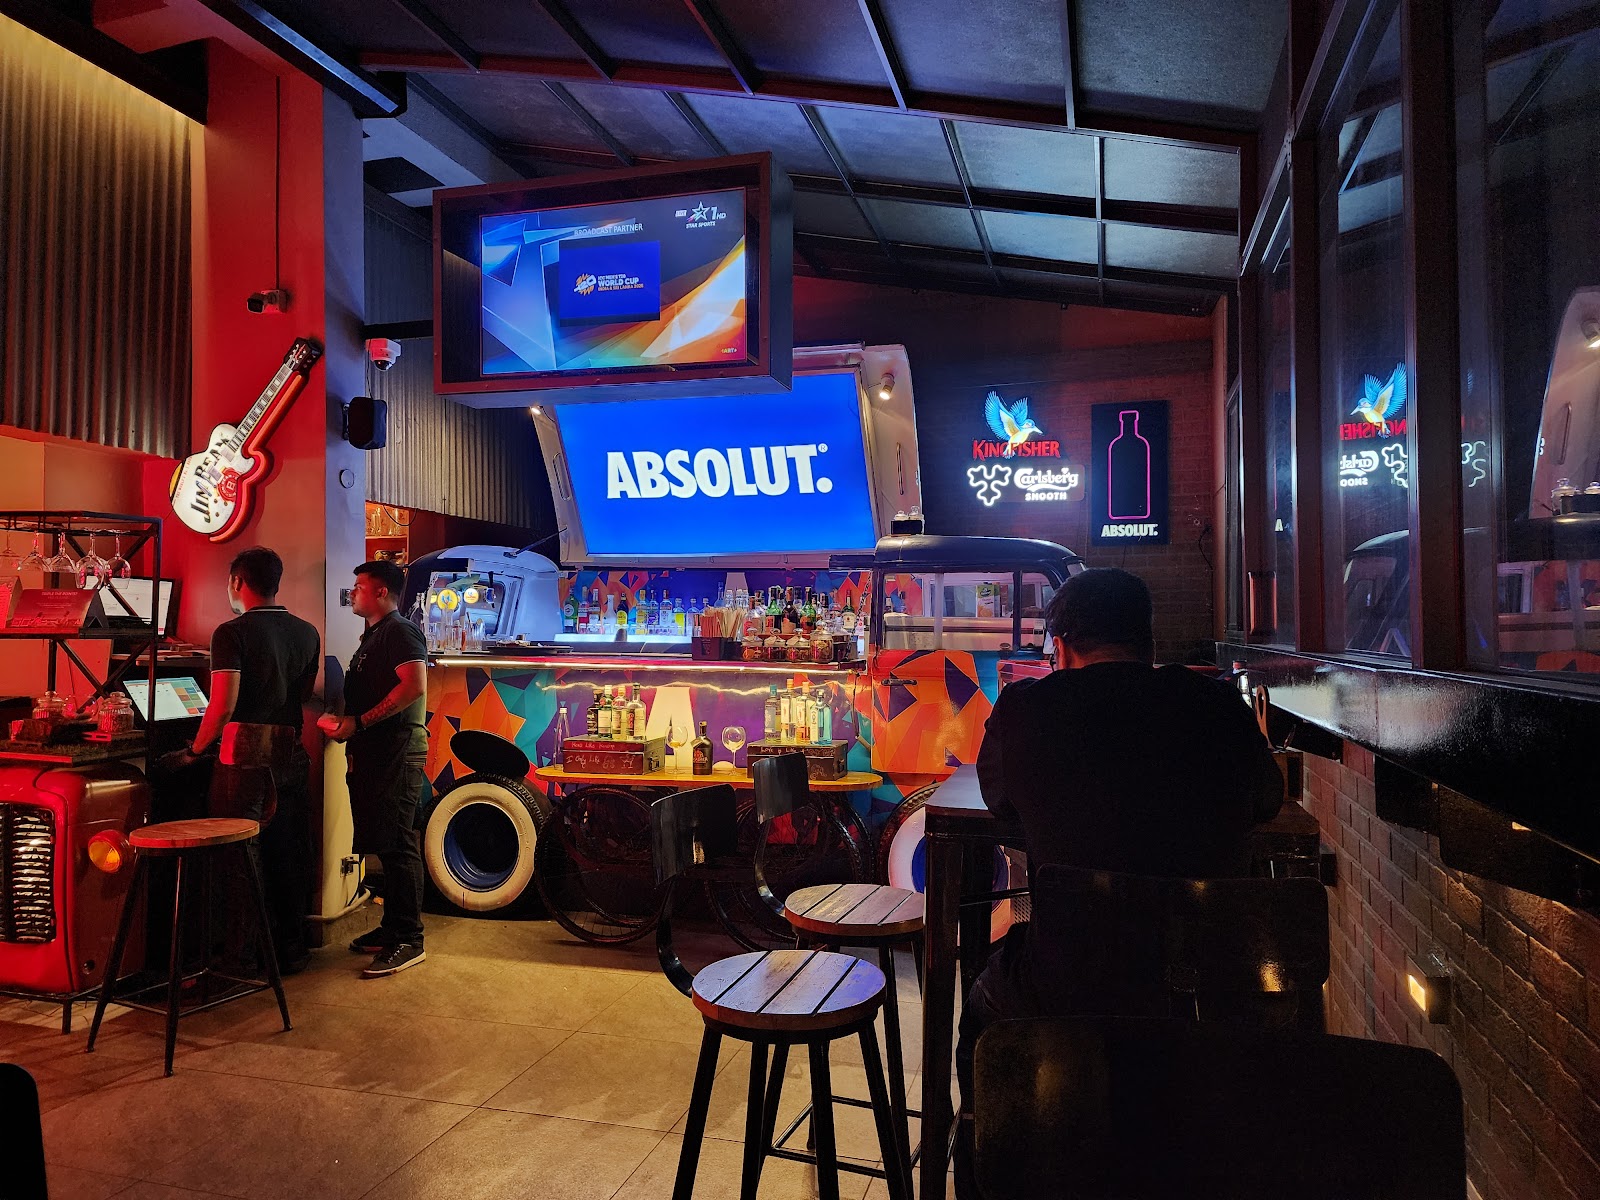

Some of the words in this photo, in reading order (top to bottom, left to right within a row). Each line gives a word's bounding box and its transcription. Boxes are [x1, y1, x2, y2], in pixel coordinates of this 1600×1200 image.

[574, 226, 613, 237] BROADCAST
[613, 223, 644, 234] PARTNER
[598, 278, 624, 287] WORLD
[625, 277, 640, 285] CUP
[1013, 467, 1079, 493] Carlsberg
[191, 480, 213, 524] JIM
[1024, 491, 1068, 502] SMOOTH
[1100, 523, 1159, 538] ABSOLUT.
